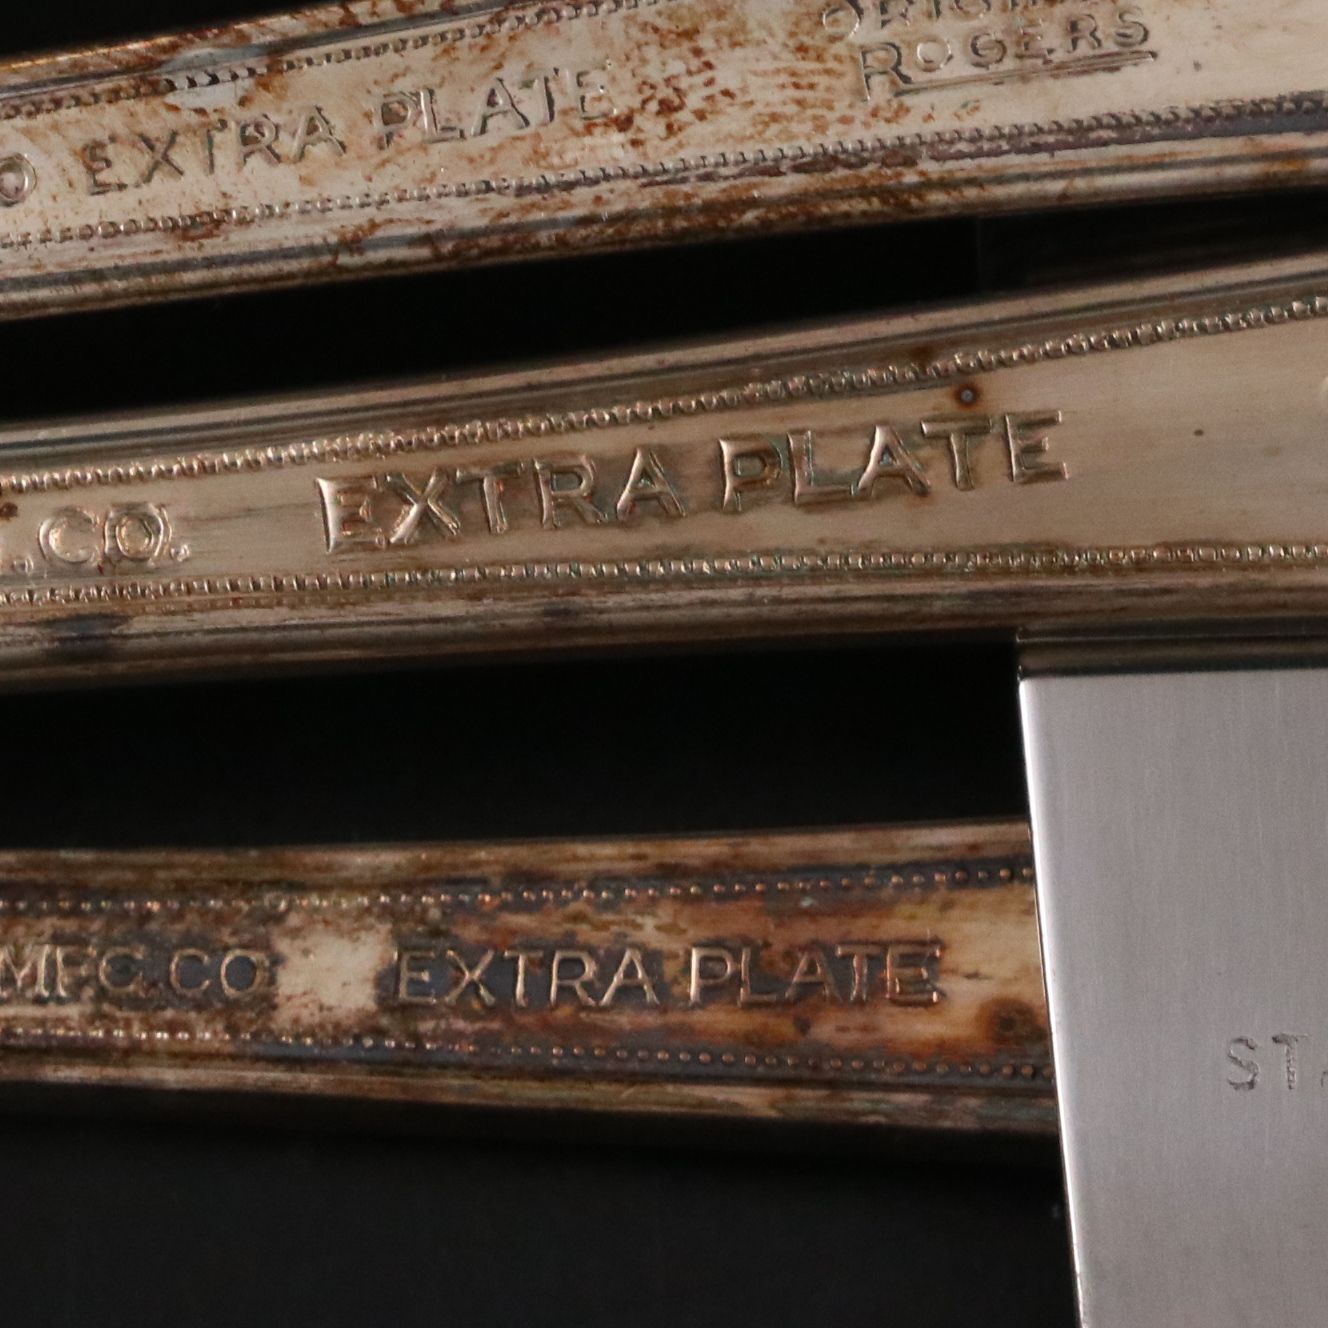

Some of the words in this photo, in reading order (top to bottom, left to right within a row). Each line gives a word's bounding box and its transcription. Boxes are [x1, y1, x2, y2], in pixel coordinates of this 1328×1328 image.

[857, 4, 1151, 103] ROGERS
[80, 102, 348, 197] EXTRA
[375, 64, 618, 151] PLATE
[314, 444, 689, 556] EXTRA
[717, 409, 1070, 513] PLATE
[391, 945, 665, 1008] EXTRA
[687, 937, 948, 1008] PLATE
